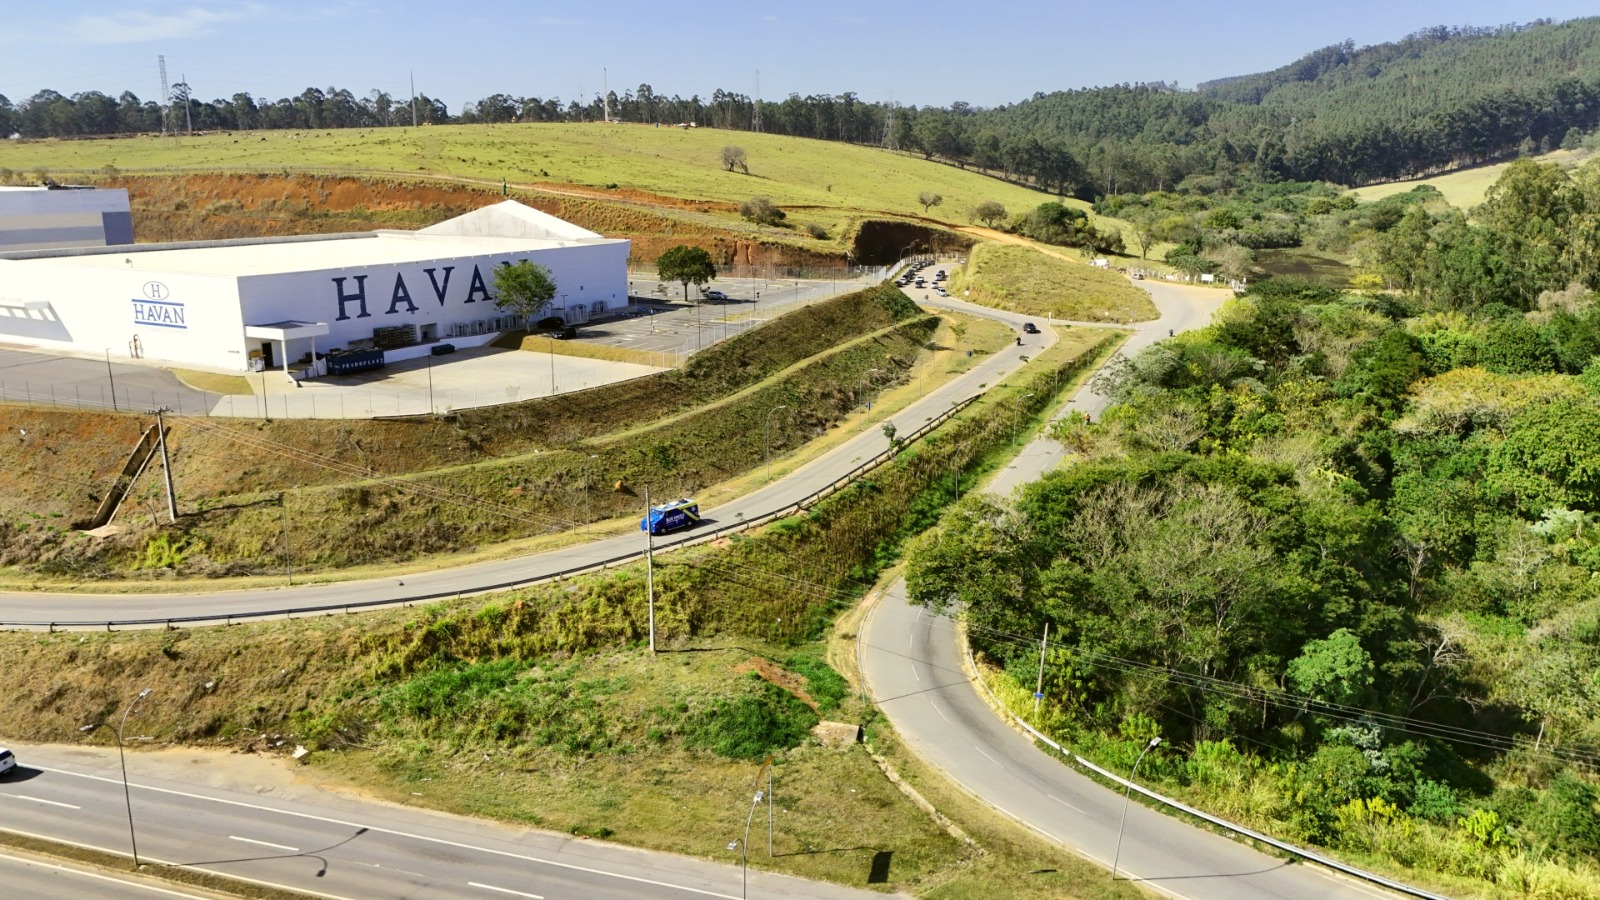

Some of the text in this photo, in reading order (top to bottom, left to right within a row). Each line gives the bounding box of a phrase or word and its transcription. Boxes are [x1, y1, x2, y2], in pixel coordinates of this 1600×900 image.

[151, 284, 161, 298] H
[332, 259, 528, 321] HAVA
[133, 303, 185, 324] HAVAN
